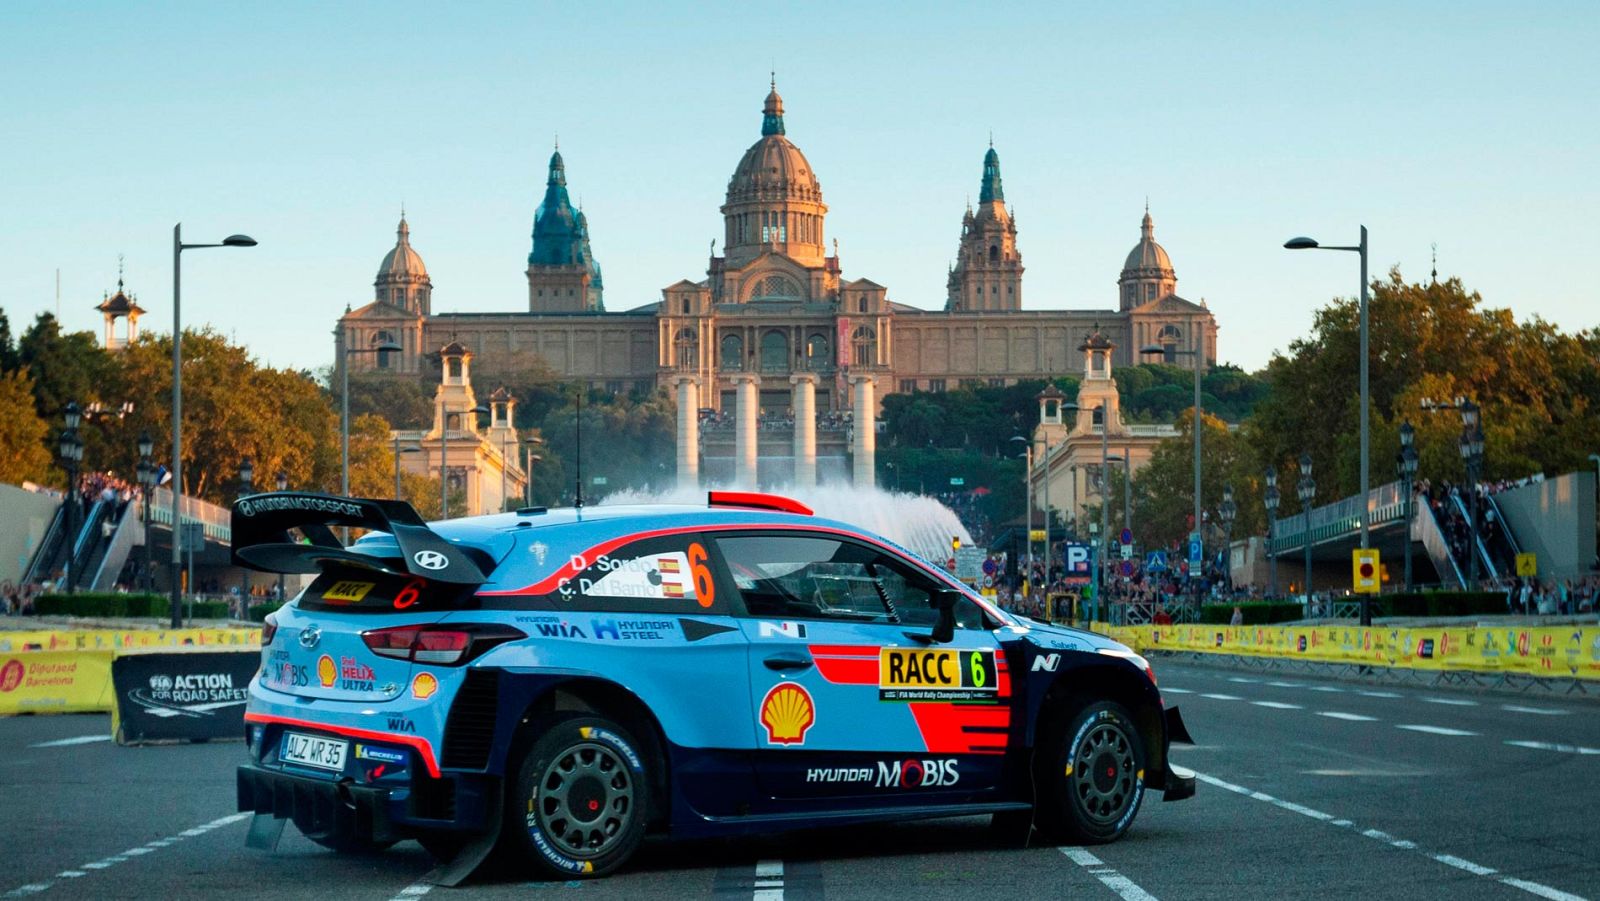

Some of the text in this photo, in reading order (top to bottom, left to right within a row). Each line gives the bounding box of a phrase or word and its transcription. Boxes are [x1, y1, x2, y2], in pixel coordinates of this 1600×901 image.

[570, 554, 651, 573] D. Sordo
[1067, 546, 1088, 572] P
[688, 542, 714, 608] 6
[332, 582, 365, 597] RACC
[393, 576, 427, 609] 6
[558, 577, 577, 595] C.
[579, 578, 606, 597] Del
[515, 616, 560, 624] HYUNDAI
[619, 621, 674, 630] HYUNDAI
[621, 632, 664, 640] STEEL
[275, 662, 309, 687] MOBIS
[342, 663, 376, 681] HELIX
[889, 651, 985, 688] RACC 6
[174, 674, 233, 690] ACTION
[342, 680, 375, 692] ULTRA
[152, 688, 248, 702] FOR ROAD SAFET
[909, 691, 923, 699] World
[924, 691, 936, 700] Rally
[937, 691, 970, 700] Championship
[286, 737, 342, 766] ALZ WR 35
[368, 750, 404, 761] MICHELIN
[806, 758, 960, 789] HYUNDAI MOBIS
[533, 832, 575, 871] MICHELIN
